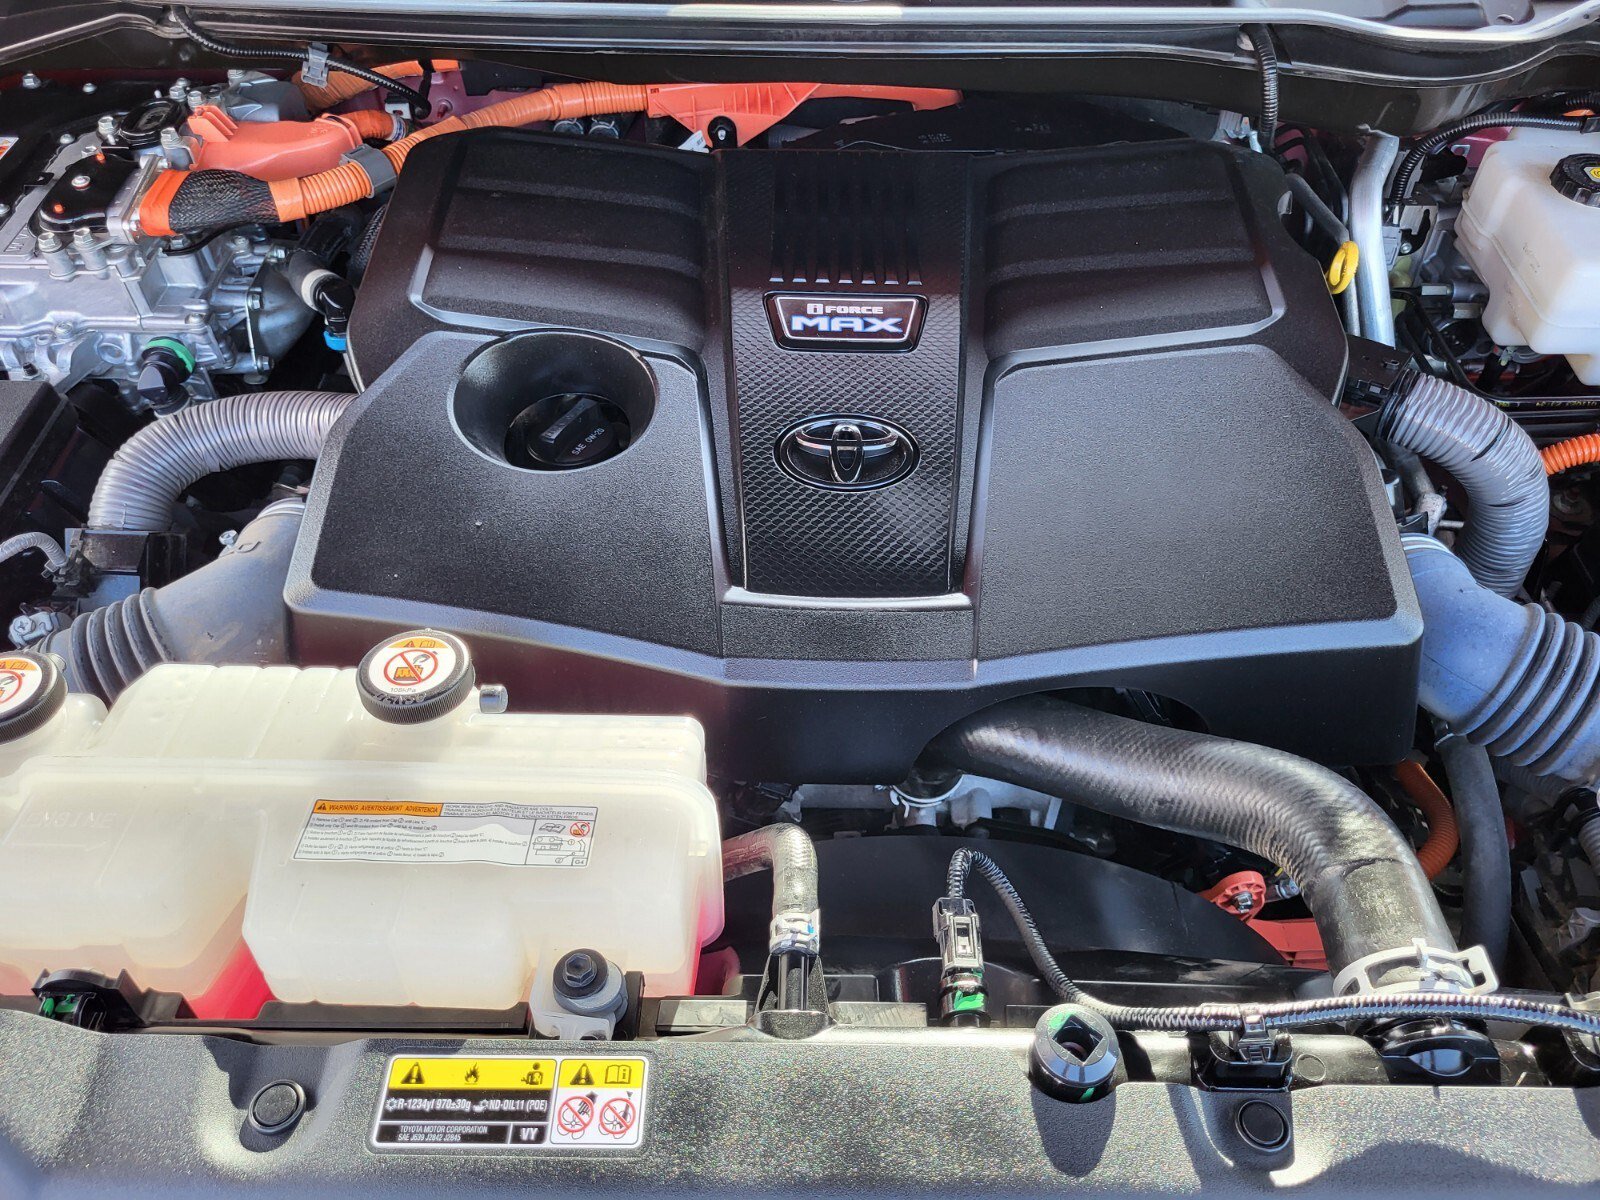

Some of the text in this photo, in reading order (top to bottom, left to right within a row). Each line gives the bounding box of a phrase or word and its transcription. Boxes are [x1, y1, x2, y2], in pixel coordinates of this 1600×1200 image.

[825, 305, 884, 315] FORCE
[791, 315, 904, 333] MAX
[571, 427, 605, 456] SAE 0W-20
[328, 804, 438, 813] WARNING AVERTISSEMENT ADVERTENCIA
[396, 1097, 548, 1113] R-1234yf 970±30g ND-OIL11 (POE)
[399, 1125, 488, 1135] TOYOTA MOTOR CORPORATION
[520, 1127, 539, 1142] VY
[397, 1133, 462, 1142] SAE J639 J2842 J2845
